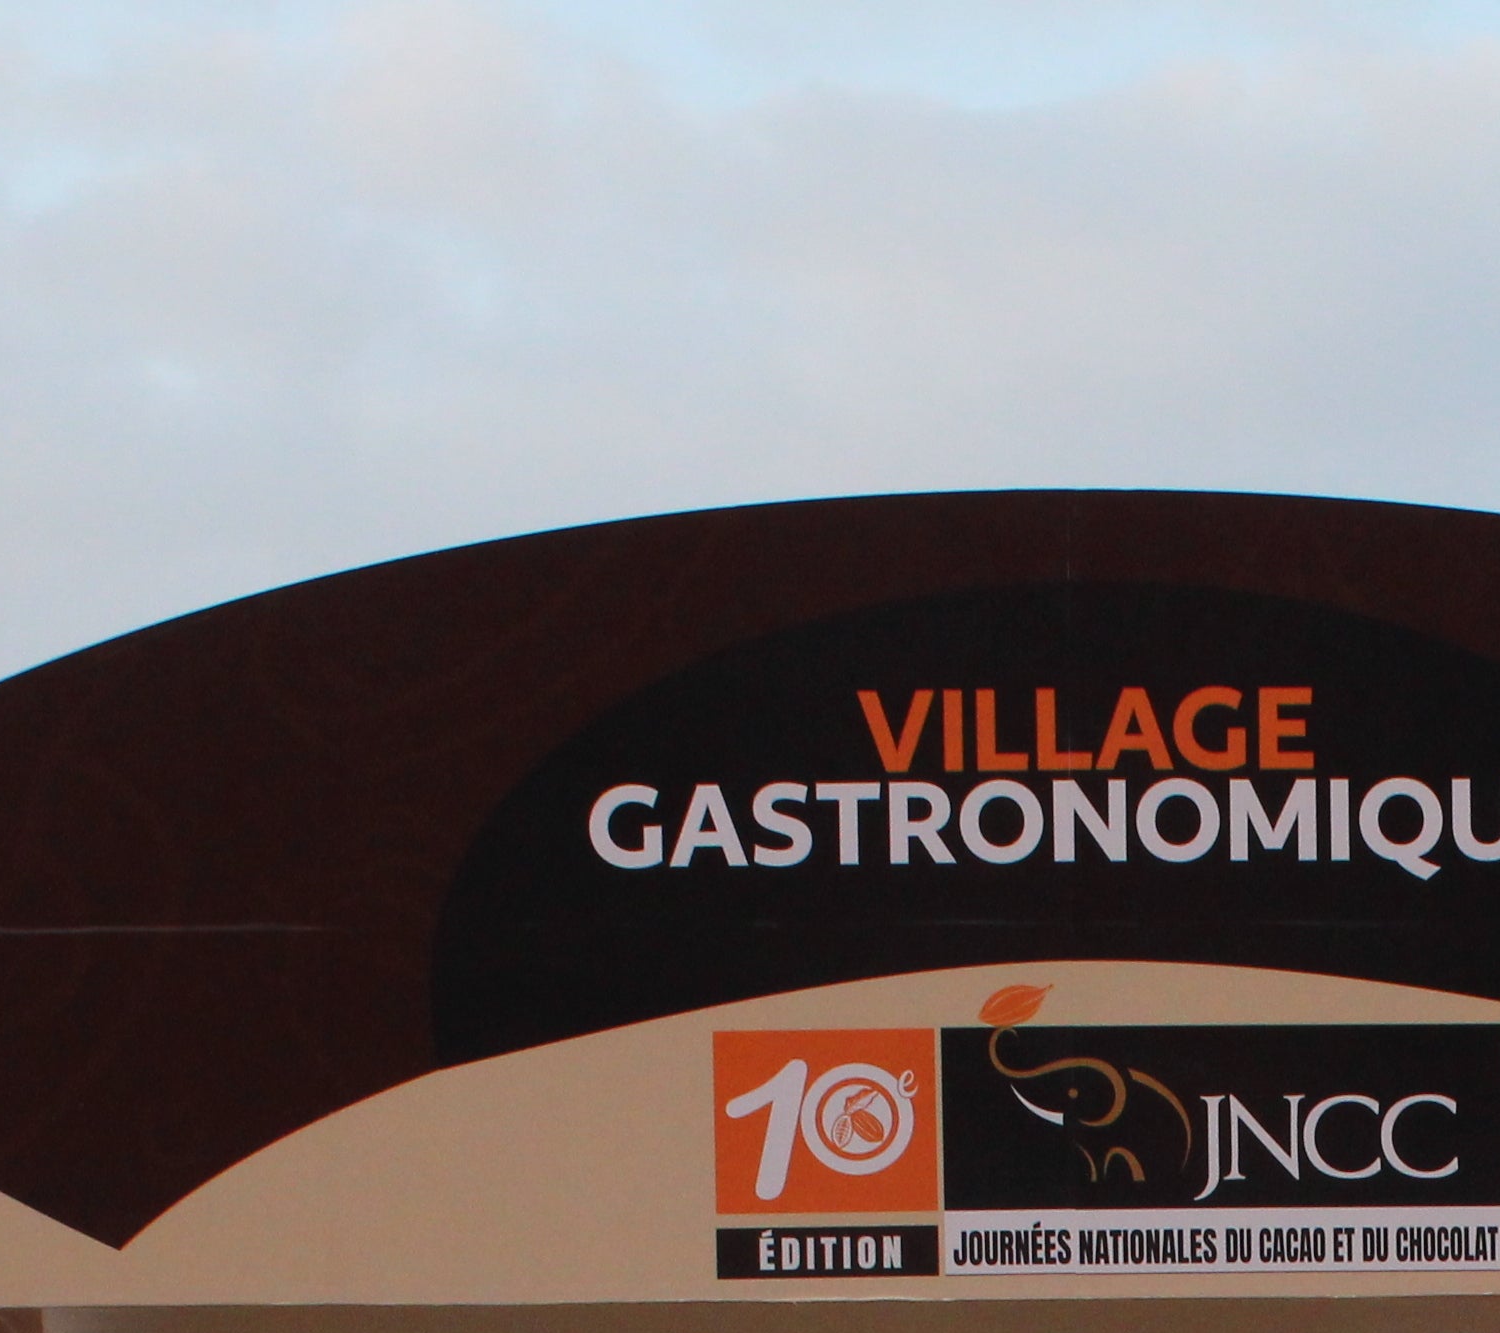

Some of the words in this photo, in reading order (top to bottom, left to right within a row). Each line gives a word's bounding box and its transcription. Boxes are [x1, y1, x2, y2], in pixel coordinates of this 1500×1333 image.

[857, 686, 1315, 772] VILLAGE
[1193, 1094, 1460, 1201] JNCC
[758, 1229, 903, 1271] ÉDITION
[953, 1221, 1072, 1266] JOURNÉES
[1078, 1228, 1218, 1265] NATIONALES
[1225, 1228, 1252, 1263] DU
[1259, 1227, 1326, 1263] CACAO
[1333, 1227, 1355, 1262] ET
[1362, 1227, 1389, 1262] DU
[1395, 1226, 1499, 1262] CHOCOLAT
